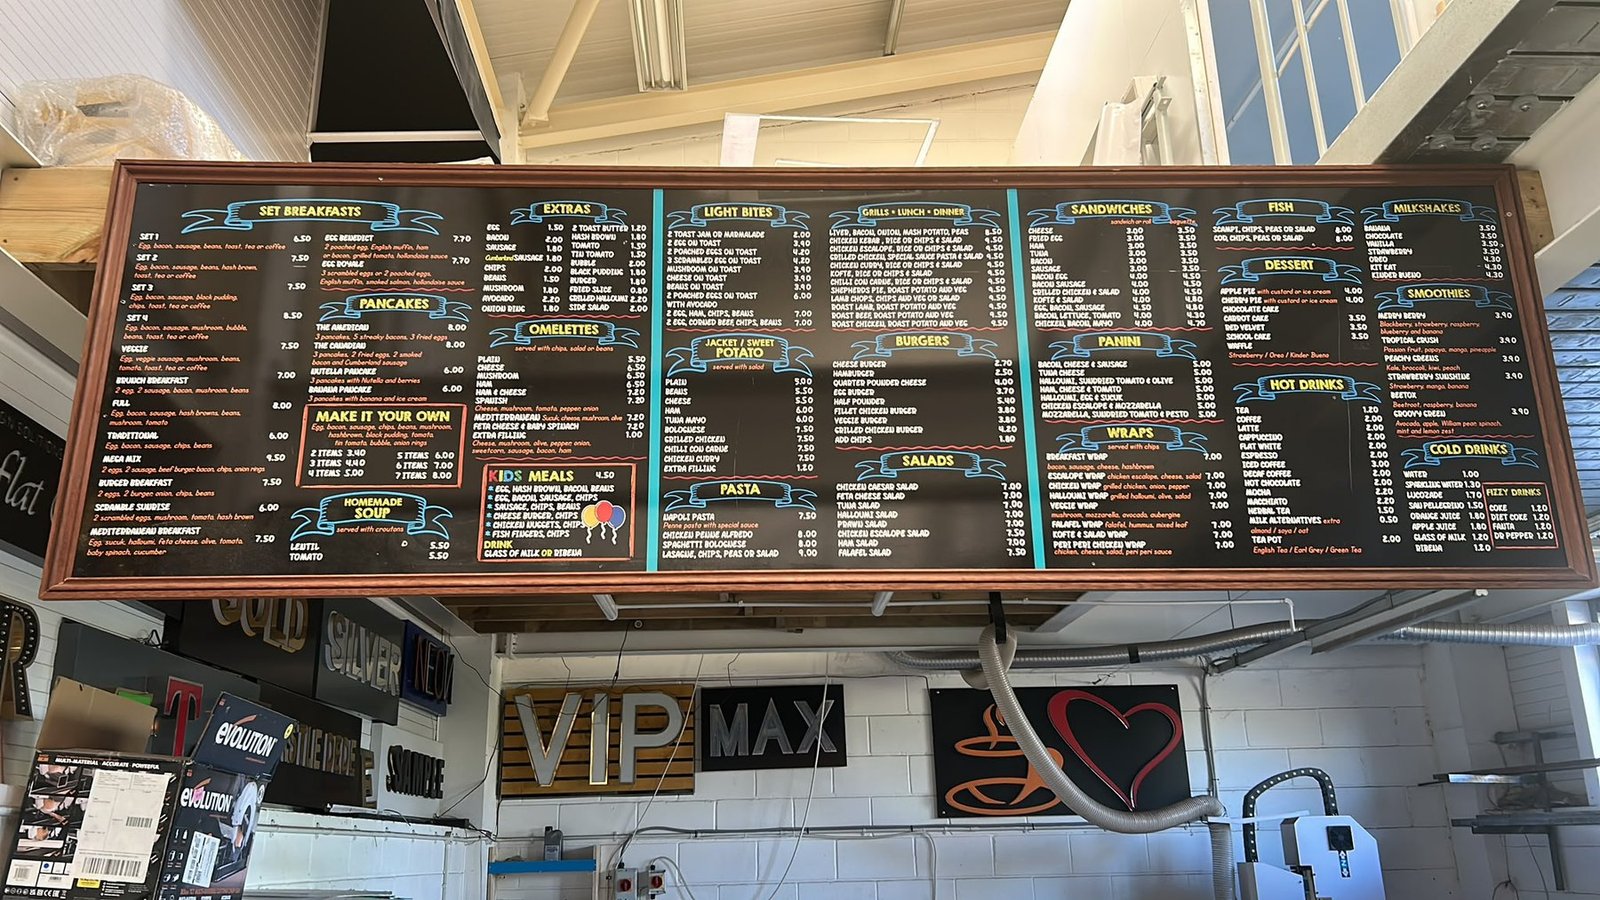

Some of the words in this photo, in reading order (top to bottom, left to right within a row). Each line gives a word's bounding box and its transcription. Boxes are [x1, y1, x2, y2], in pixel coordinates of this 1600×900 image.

[260, 206, 281, 216] SET
[284, 206, 361, 216] BREAKFASTS
[543, 203, 591, 215] EXTRAS
[705, 207, 738, 216] LIGHT
[742, 207, 772, 217] BITES
[1072, 204, 1152, 214] SANDWICHES
[1269, 202, 1293, 212] FISH
[1394, 204, 1460, 213] MILKSHAKES
[1265, 260, 1313, 270] DESSERT
[1408, 289, 1470, 298] SMOOTHIES
[359, 298, 430, 310] PANCAKES
[529, 324, 599, 334] OMELETTES
[896, 335, 949, 346] BURGERS
[1099, 336, 1141, 346] PANINI
[715, 348, 764, 359] POTATO
[995, 368, 1013, 376] 2.50
[1270, 380, 1295, 390] HOT
[1299, 379, 1344, 391] DRINKS
[796, 396, 813, 404] 5.50
[316, 411, 357, 422] MAKE
[361, 411, 373, 421] IT
[378, 411, 413, 421] YOUR
[417, 411, 449, 421] OWN
[1107, 428, 1154, 438] WRAPS
[1430, 444, 1461, 454] COLD
[1465, 444, 1508, 454] DRINKS
[903, 455, 954, 466] SALADS
[489, 470, 522, 482] KIDS
[529, 471, 573, 482] MEALS
[263, 478, 281, 486] 7.50
[721, 484, 760, 494] PASTA
[345, 498, 402, 506] HOMEMADE
[1003, 500, 1023, 509] 7.00
[355, 507, 390, 518] SOUP
[484, 540, 513, 549] DRINK
[838, 539, 854, 547] HAM
[856, 539, 878, 547] SALAD
[1007, 538, 1025, 546] 7.00
[325, 610, 402, 696] SILVER
[414, 634, 455, 704] NEON
[164, 676, 204, 757] T
[709, 699, 839, 758] MAX
[514, 692, 685, 787] VIP
[54, 757, 99, 766] MULTI-MATERIAL
[386, 745, 445, 799] SAMPLE
